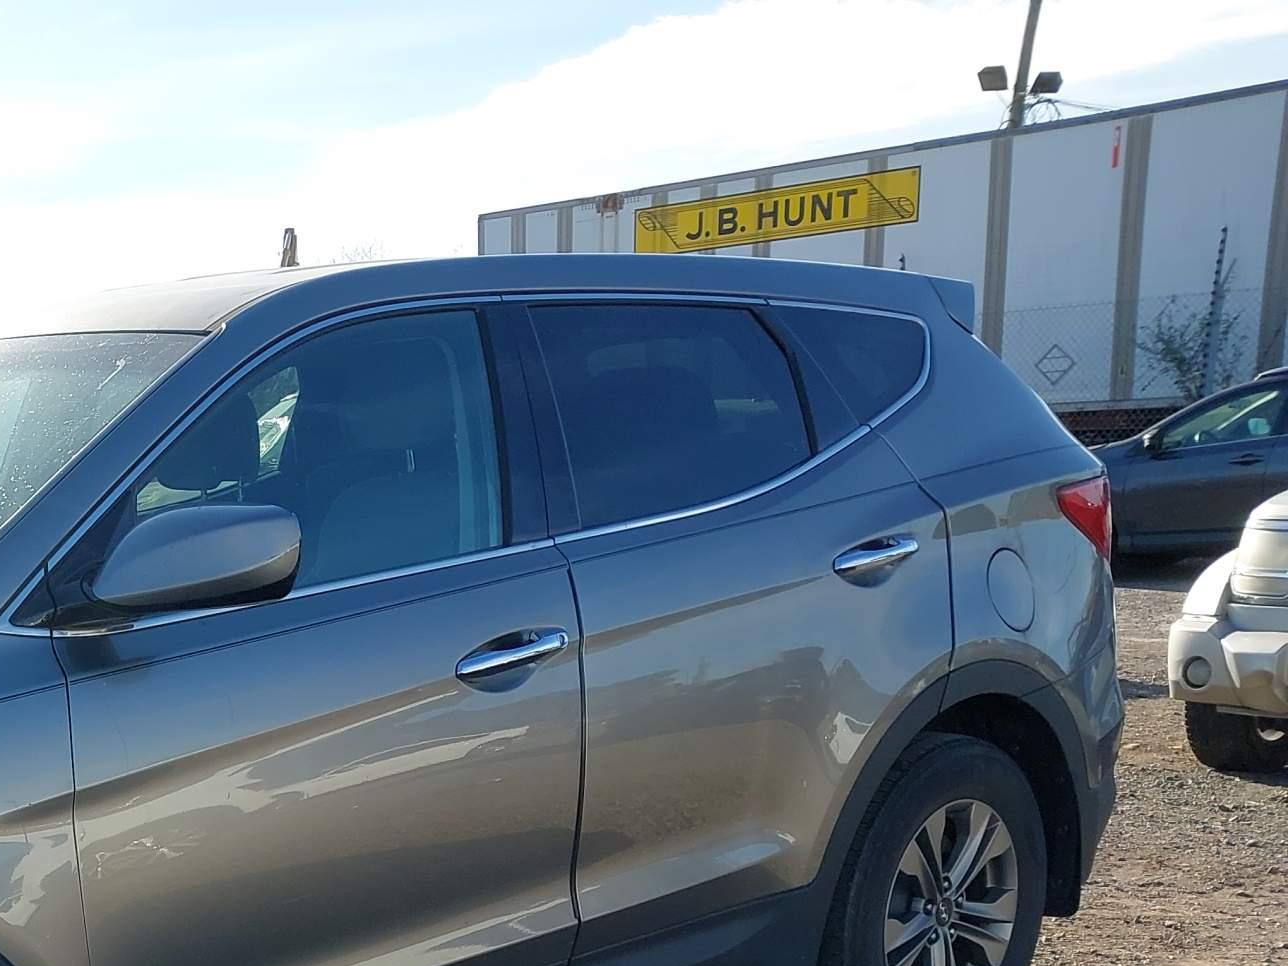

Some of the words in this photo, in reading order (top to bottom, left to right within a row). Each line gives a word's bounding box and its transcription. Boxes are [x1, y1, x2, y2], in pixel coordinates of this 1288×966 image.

[686, 211, 710, 240] J.
[718, 207, 746, 235] B.
[757, 188, 858, 230] HUNT
